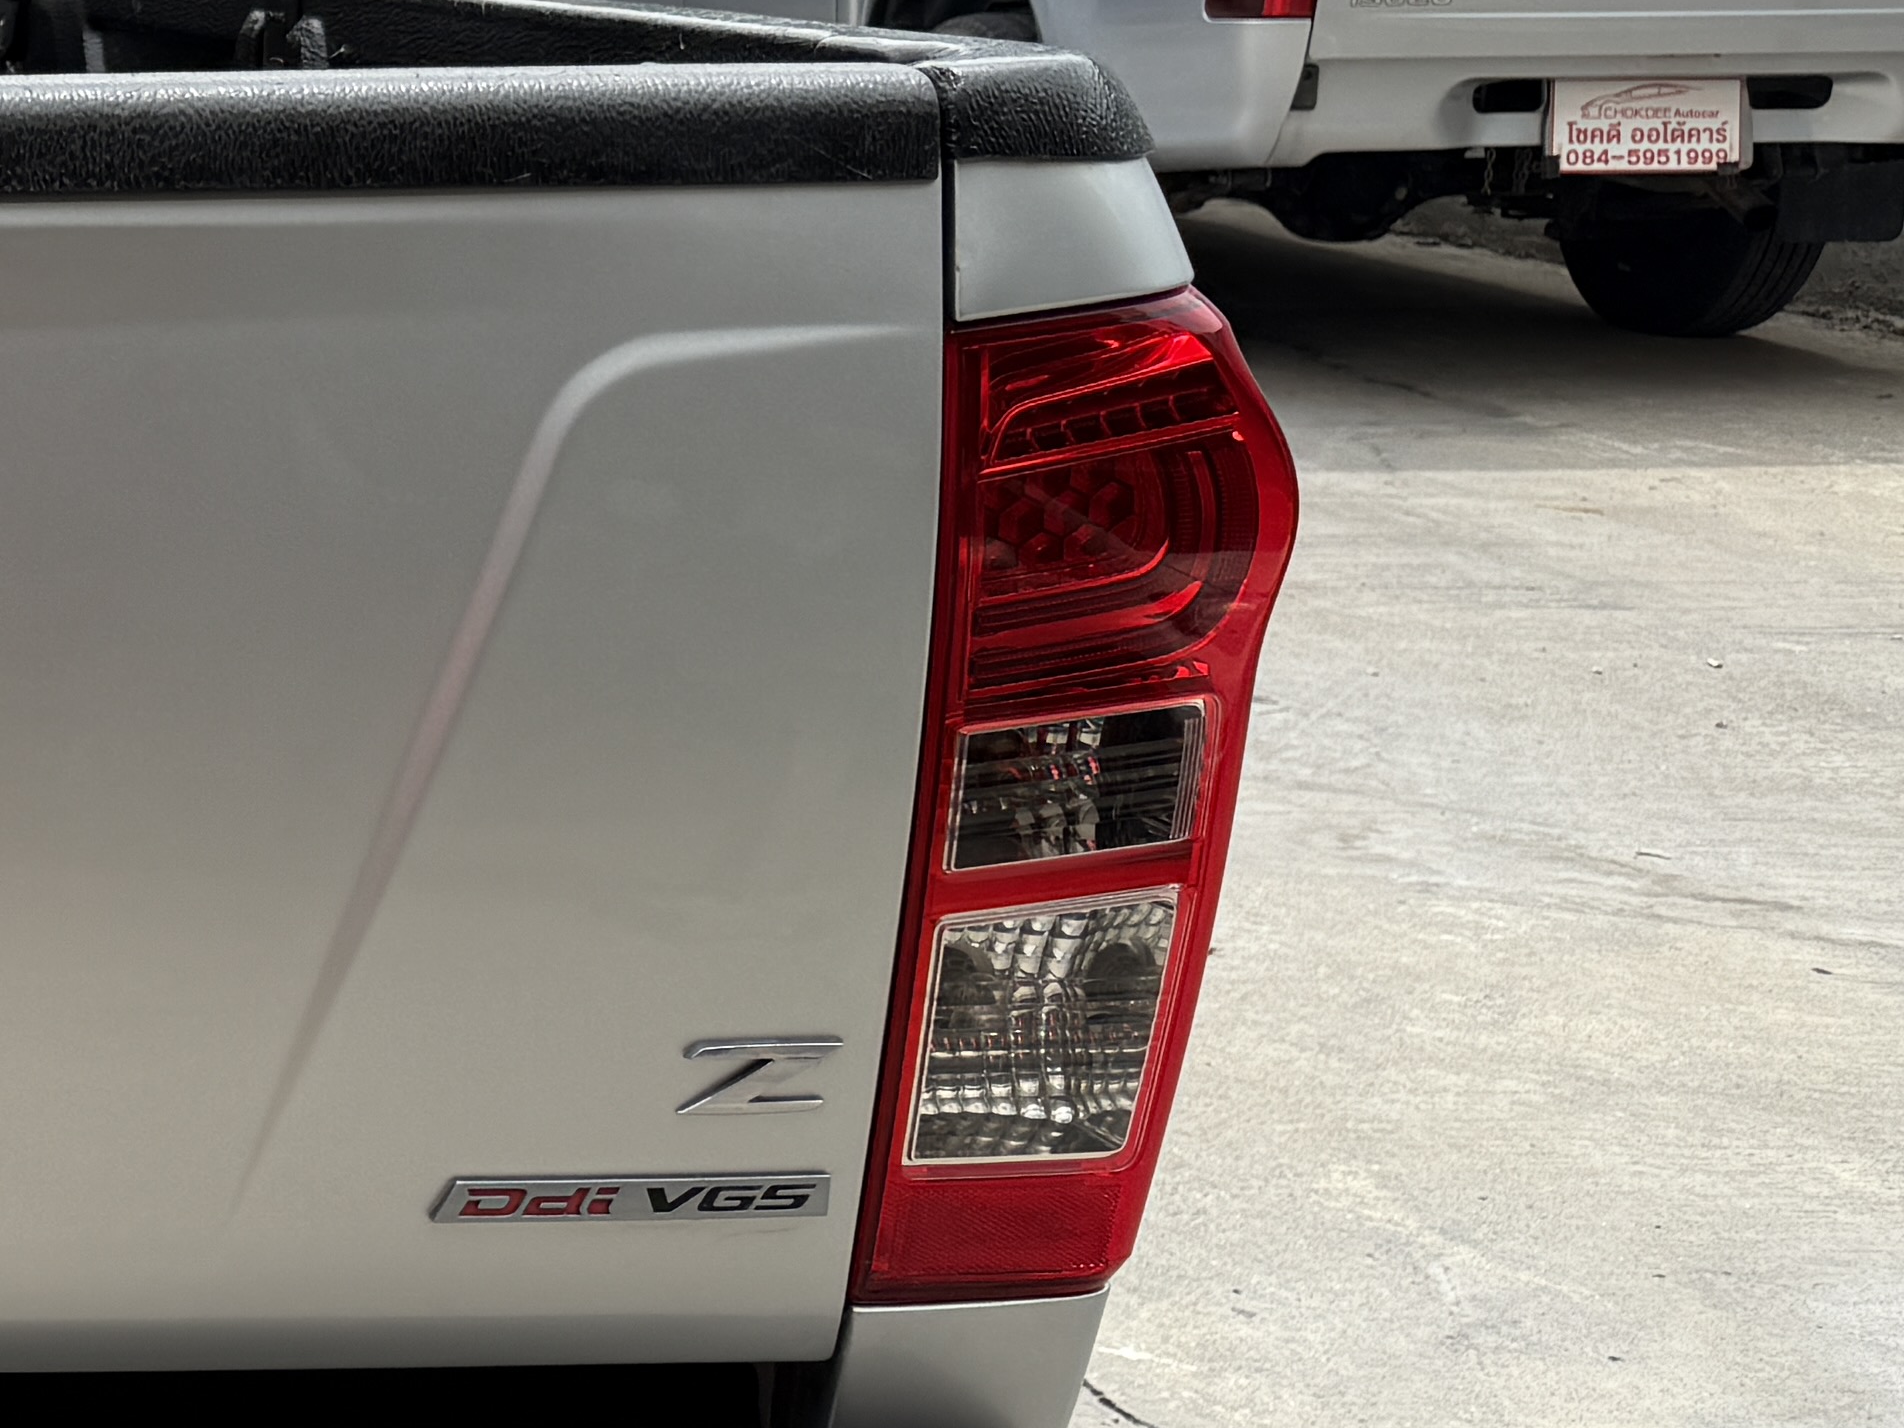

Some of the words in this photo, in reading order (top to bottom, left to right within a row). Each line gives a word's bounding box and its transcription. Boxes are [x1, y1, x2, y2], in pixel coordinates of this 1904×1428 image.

[1603, 105, 1672, 120] CHOKDEE
[1674, 107, 1720, 120] Autocar
[1567, 121, 1622, 145] โชคดี
[1630, 120, 1729, 145] ออโต้คาร์
[1566, 148, 1729, 166] 084-5951999
[676, 1037, 845, 1116] Z
[457, 1186, 621, 1218] Ddi
[645, 1183, 817, 1214] VGS
